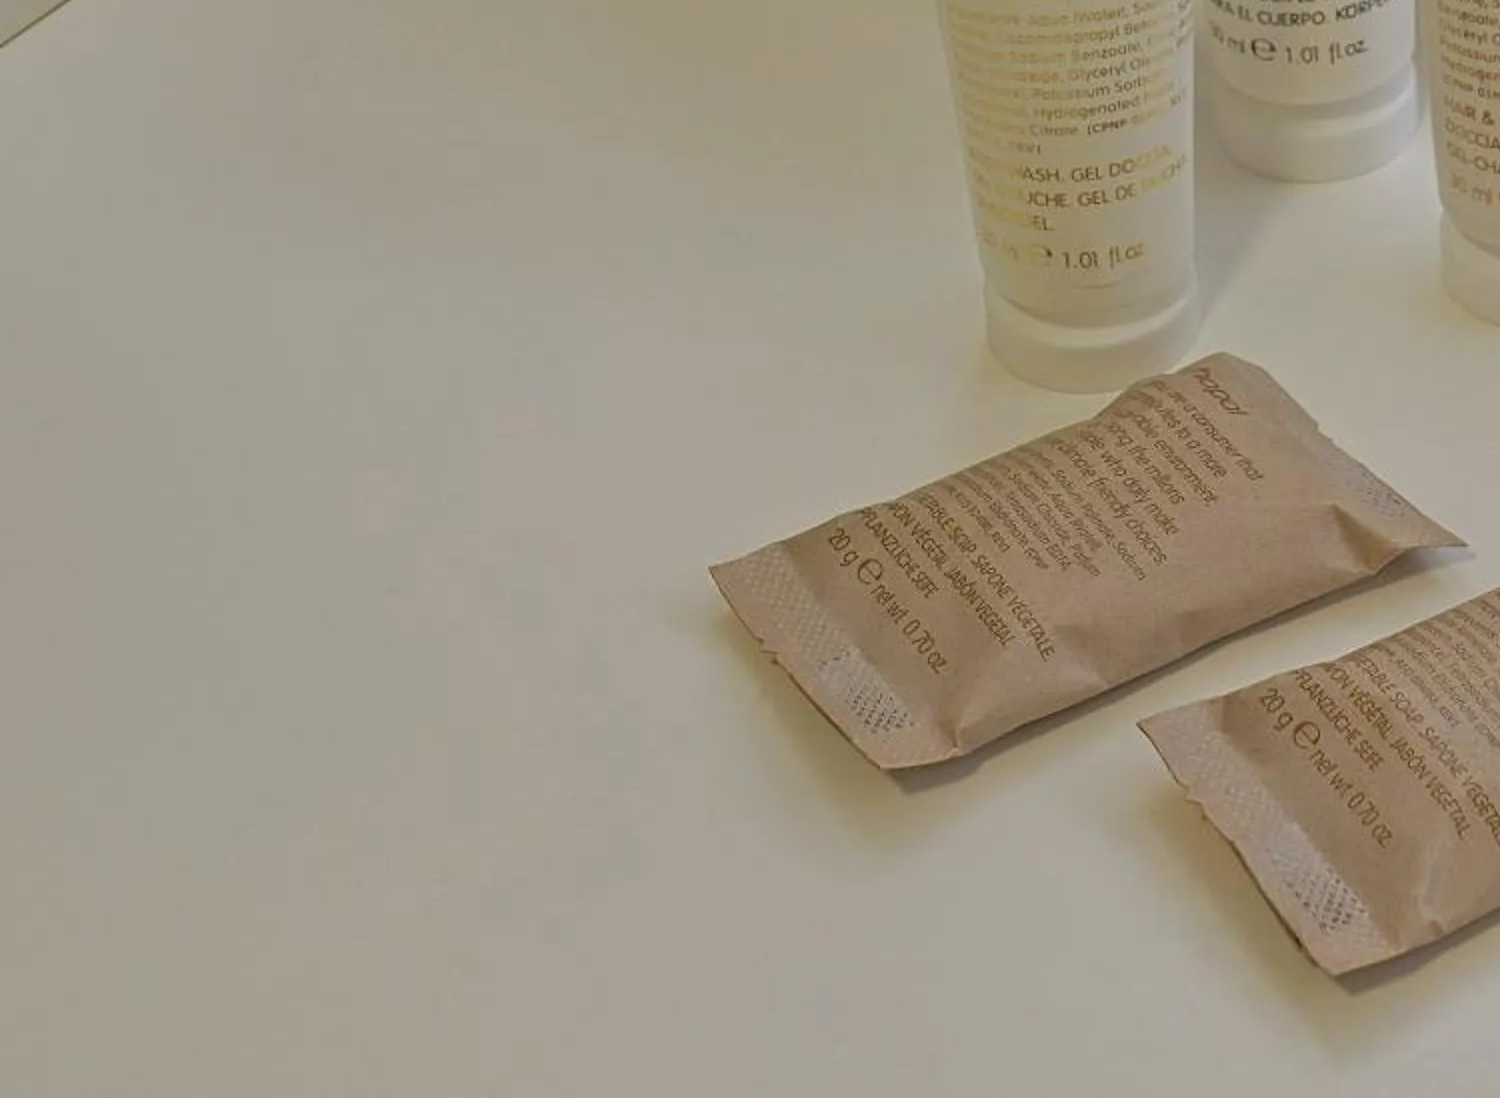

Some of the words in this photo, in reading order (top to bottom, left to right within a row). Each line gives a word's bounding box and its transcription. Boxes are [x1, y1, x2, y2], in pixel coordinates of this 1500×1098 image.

[1482, 110, 1496, 127] &
[1071, 166, 1103, 183] GEL
[1077, 189, 1111, 207] GEL
[1115, 182, 1138, 202] DE
[1061, 250, 1101, 269] 1.01
[1193, 361, 1247, 415] hopal
[1100, 451, 1126, 476] who
[827, 527, 850, 550] 20
[839, 550, 858, 566] g
[870, 584, 895, 605] net
[902, 619, 934, 653] 0.70
[971, 554, 1013, 598] SAPONE
[1259, 687, 1285, 712] 20
[1273, 712, 1293, 731] g
[1309, 749, 1337, 776] net
[1347, 791, 1379, 825] 0.70
[1389, 737, 1430, 779] JABÓN
[1418, 726, 1467, 777] SAPONE
